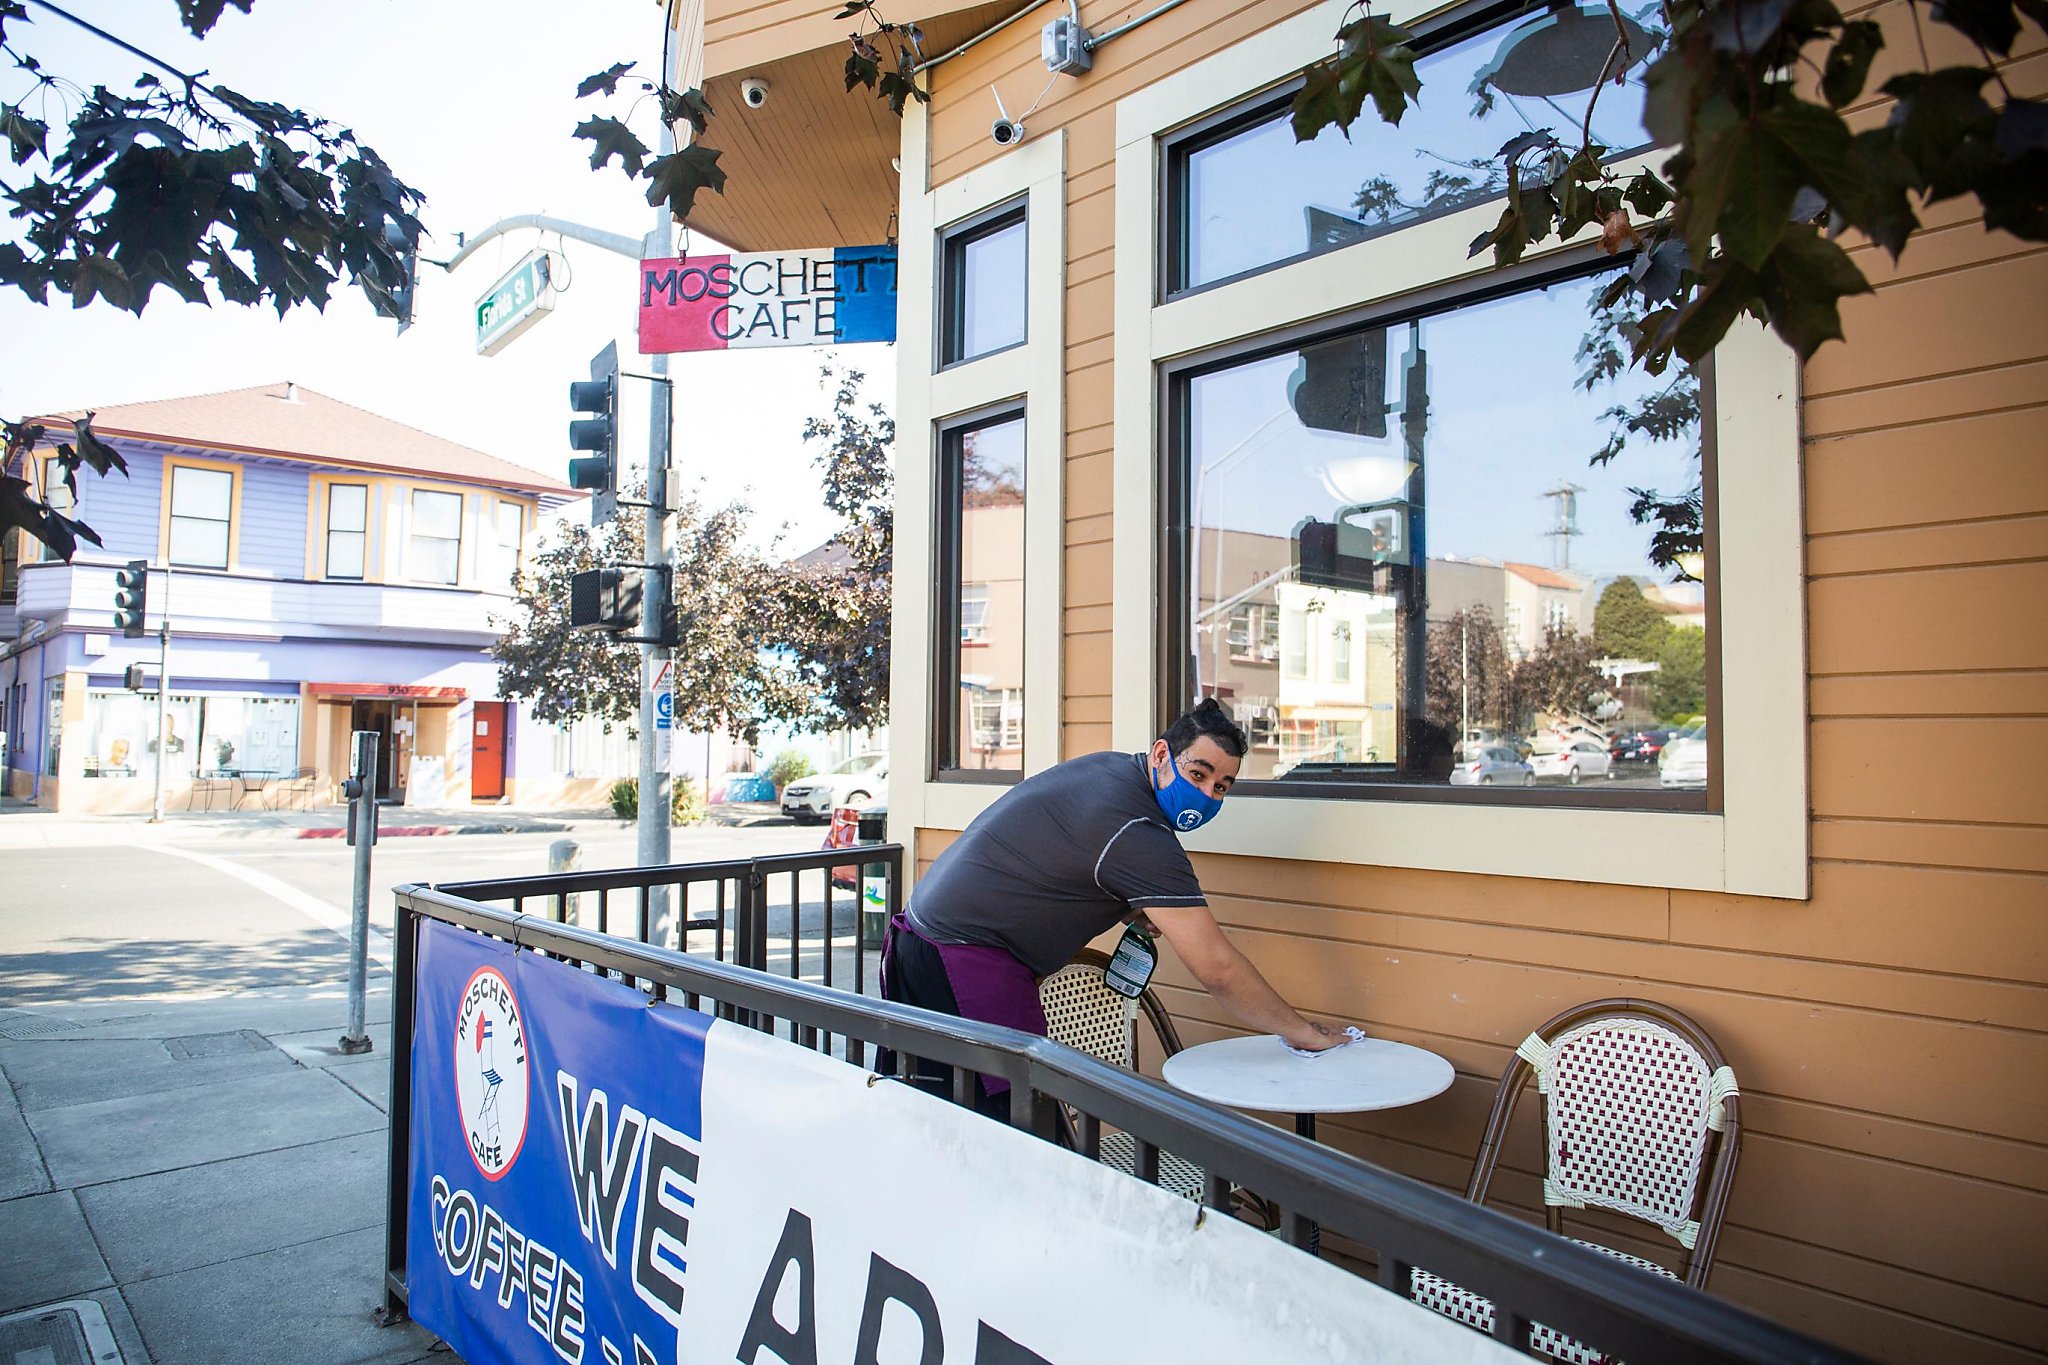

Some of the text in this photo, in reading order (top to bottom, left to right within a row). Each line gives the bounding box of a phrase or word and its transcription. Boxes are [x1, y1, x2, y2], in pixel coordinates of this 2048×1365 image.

[481, 276, 527, 333] Florida St
[711, 297, 845, 339] CAFE
[388, 685, 409, 695] 930
[458, 978, 525, 1065] MOSCHETTI
[471, 1131, 503, 1168] CAFÉ
[558, 1070, 1056, 1365] WE AR
[432, 1175, 585, 1365] COFFEE
